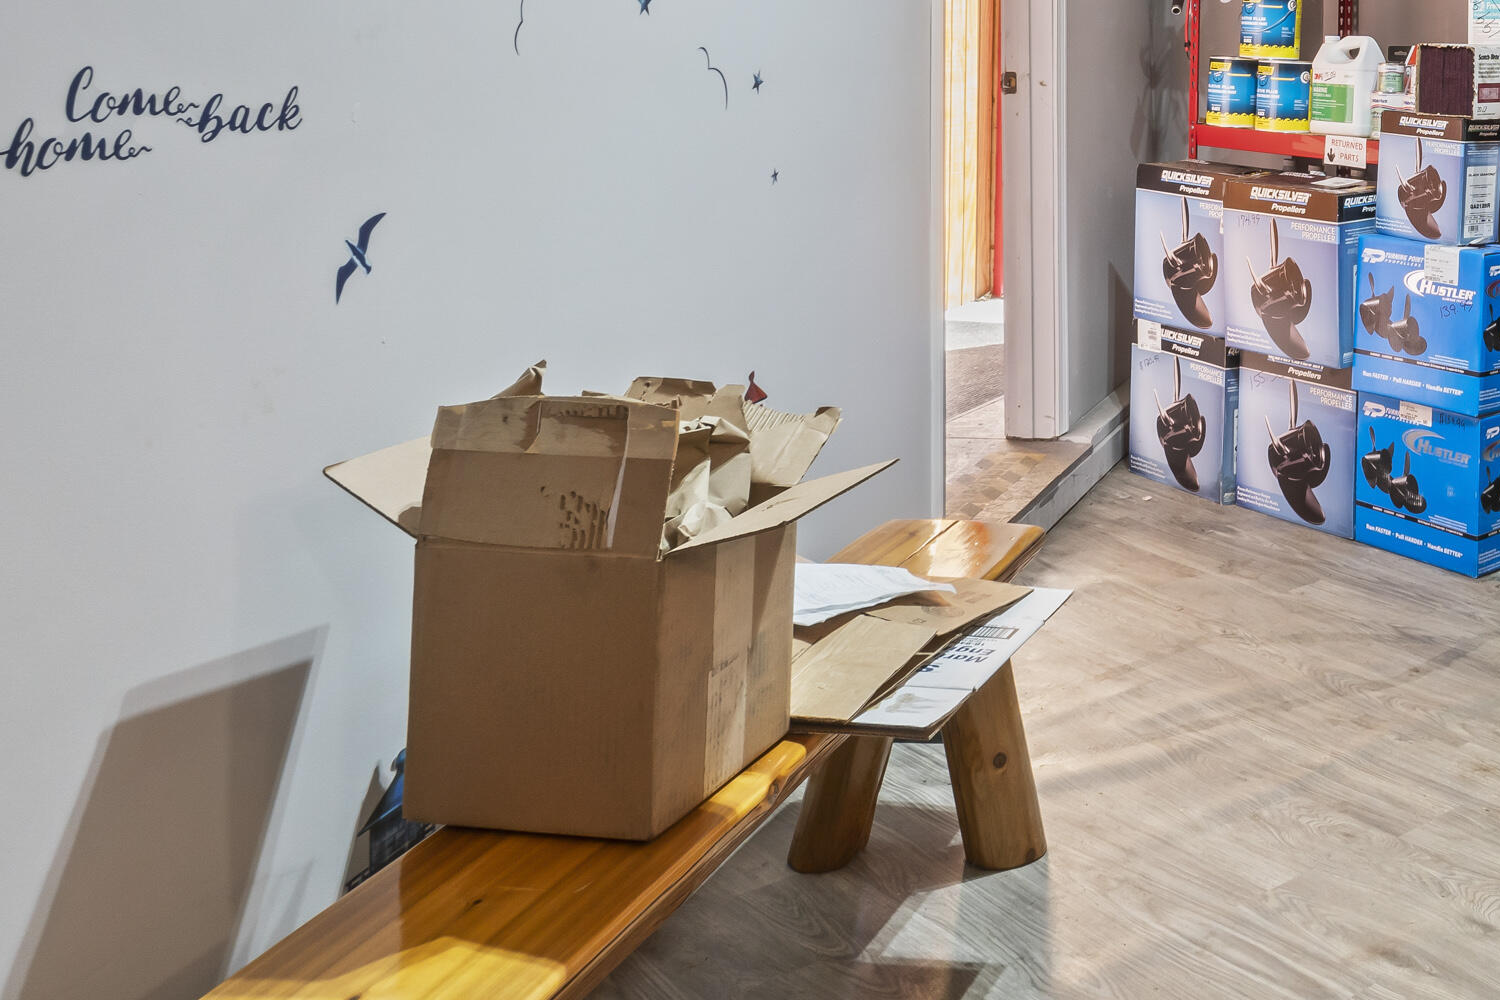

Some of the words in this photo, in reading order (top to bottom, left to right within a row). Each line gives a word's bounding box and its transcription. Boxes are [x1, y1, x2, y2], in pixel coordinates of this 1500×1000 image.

[65, 66, 200, 123] Come
[176, 86, 302, 143] back
[1399, 116, 1449, 129] QUICKSILVER
[1416, 128, 1445, 137] Propellers
[0, 117, 152, 177] home
[1331, 139, 1363, 151] RETURNED
[1339, 152, 1360, 163] PARTS
[1161, 170, 1214, 187] QUICKSILVER
[1180, 184, 1210, 196] Propellers
[1250, 186, 1311, 204] QUICKSILVER
[1271, 203, 1306, 215] Propellers
[1290, 222, 1336, 234] PERFORMANCE
[1301, 232, 1336, 241] PROPELLER
[1420, 279, 1475, 301] HUSTLER
[1160, 330, 1204, 347] UICKSILVER
[1172, 344, 1200, 357] Propellers
[1190, 363, 1224, 379] PERFORMANCE
[1288, 367, 1322, 380] Propellers
[1372, 372, 1389, 382] FASTER
[1402, 378, 1422, 388] HARDER
[1425, 383, 1443, 392] Handle
[1310, 388, 1353, 402] PERFORMANCE
[1417, 438, 1472, 464] HUSTLER
[1366, 523, 1375, 532] Run
[1375, 526, 1392, 536] FASTER
[1405, 534, 1424, 546] HARDER
[1427, 541, 1443, 552] Handle
[1443, 545, 1463, 558] BETTER
